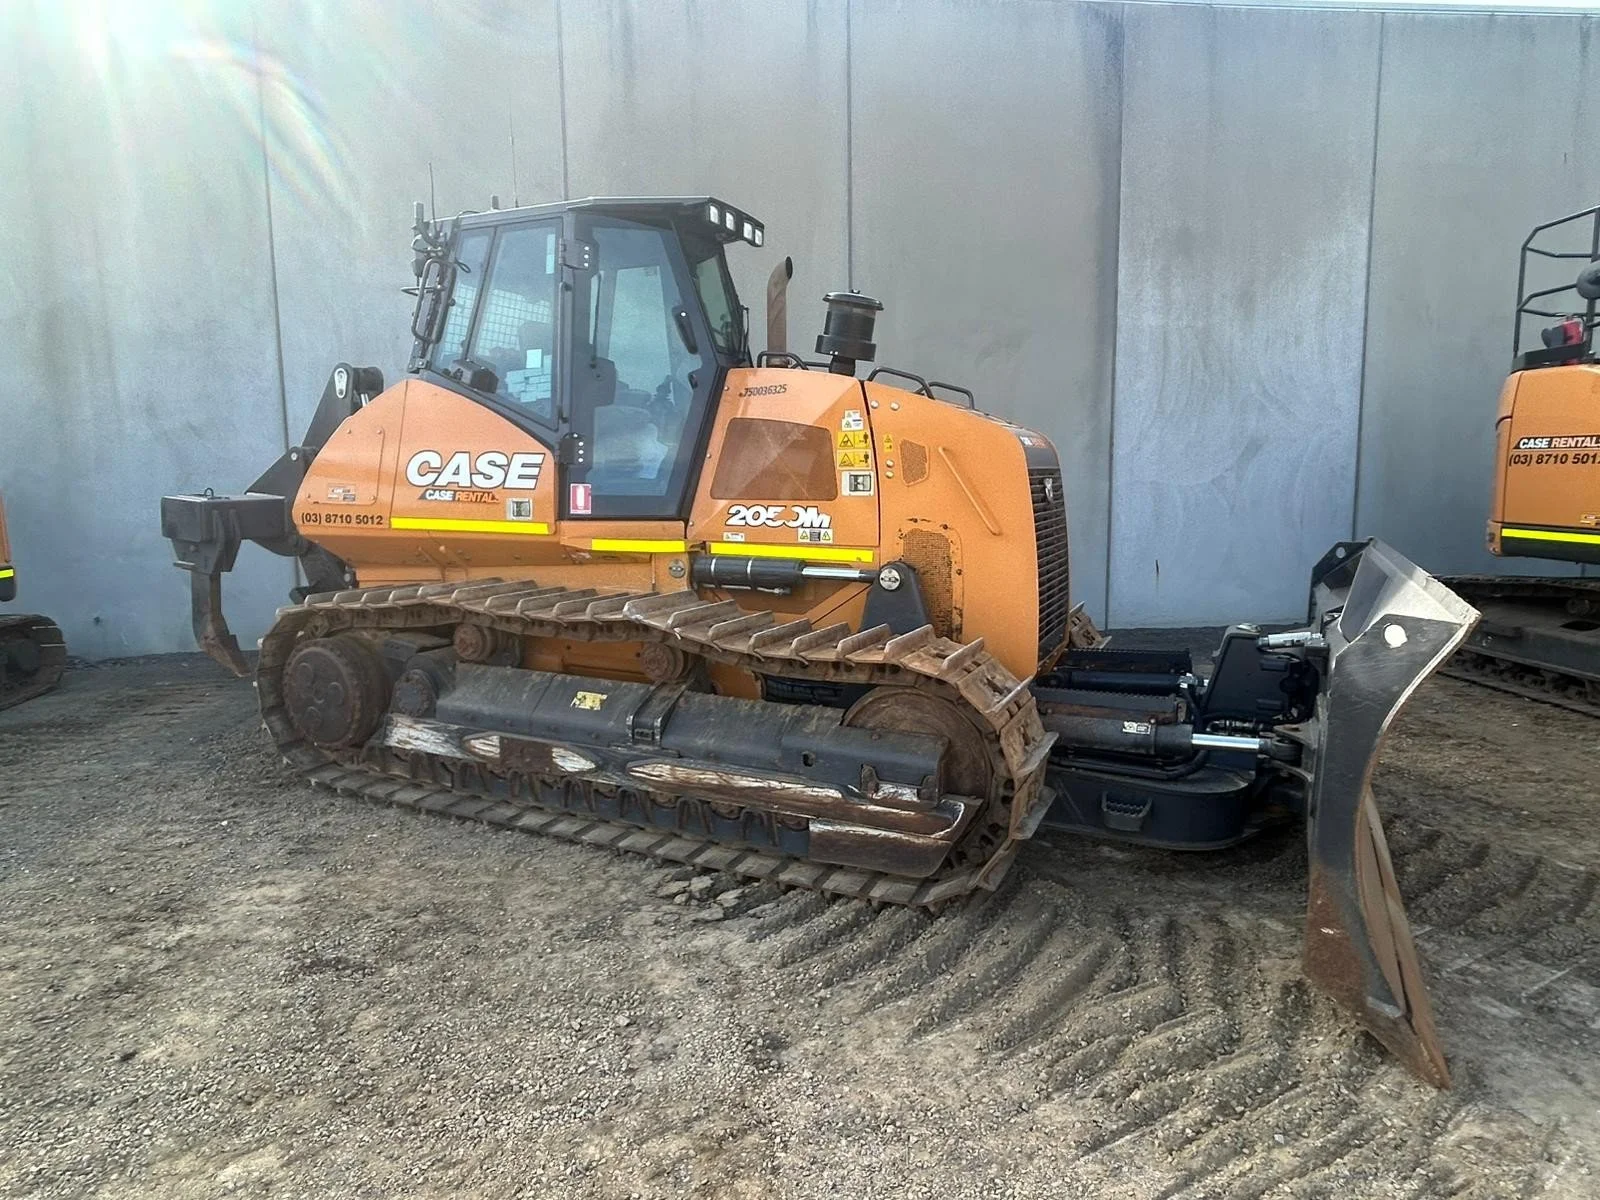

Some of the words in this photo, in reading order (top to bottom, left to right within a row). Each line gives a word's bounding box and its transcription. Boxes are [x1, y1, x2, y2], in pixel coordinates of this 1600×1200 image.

[1519, 438, 1551, 449] CASE
[1508, 454, 1533, 467] (03)
[1535, 453, 1569, 465] 8710
[405, 449, 546, 490] CASE
[424, 488, 455, 501] CASE
[301, 512, 322, 525] (03)
[325, 513, 352, 524] 8710
[355, 514, 383, 525] 5012
